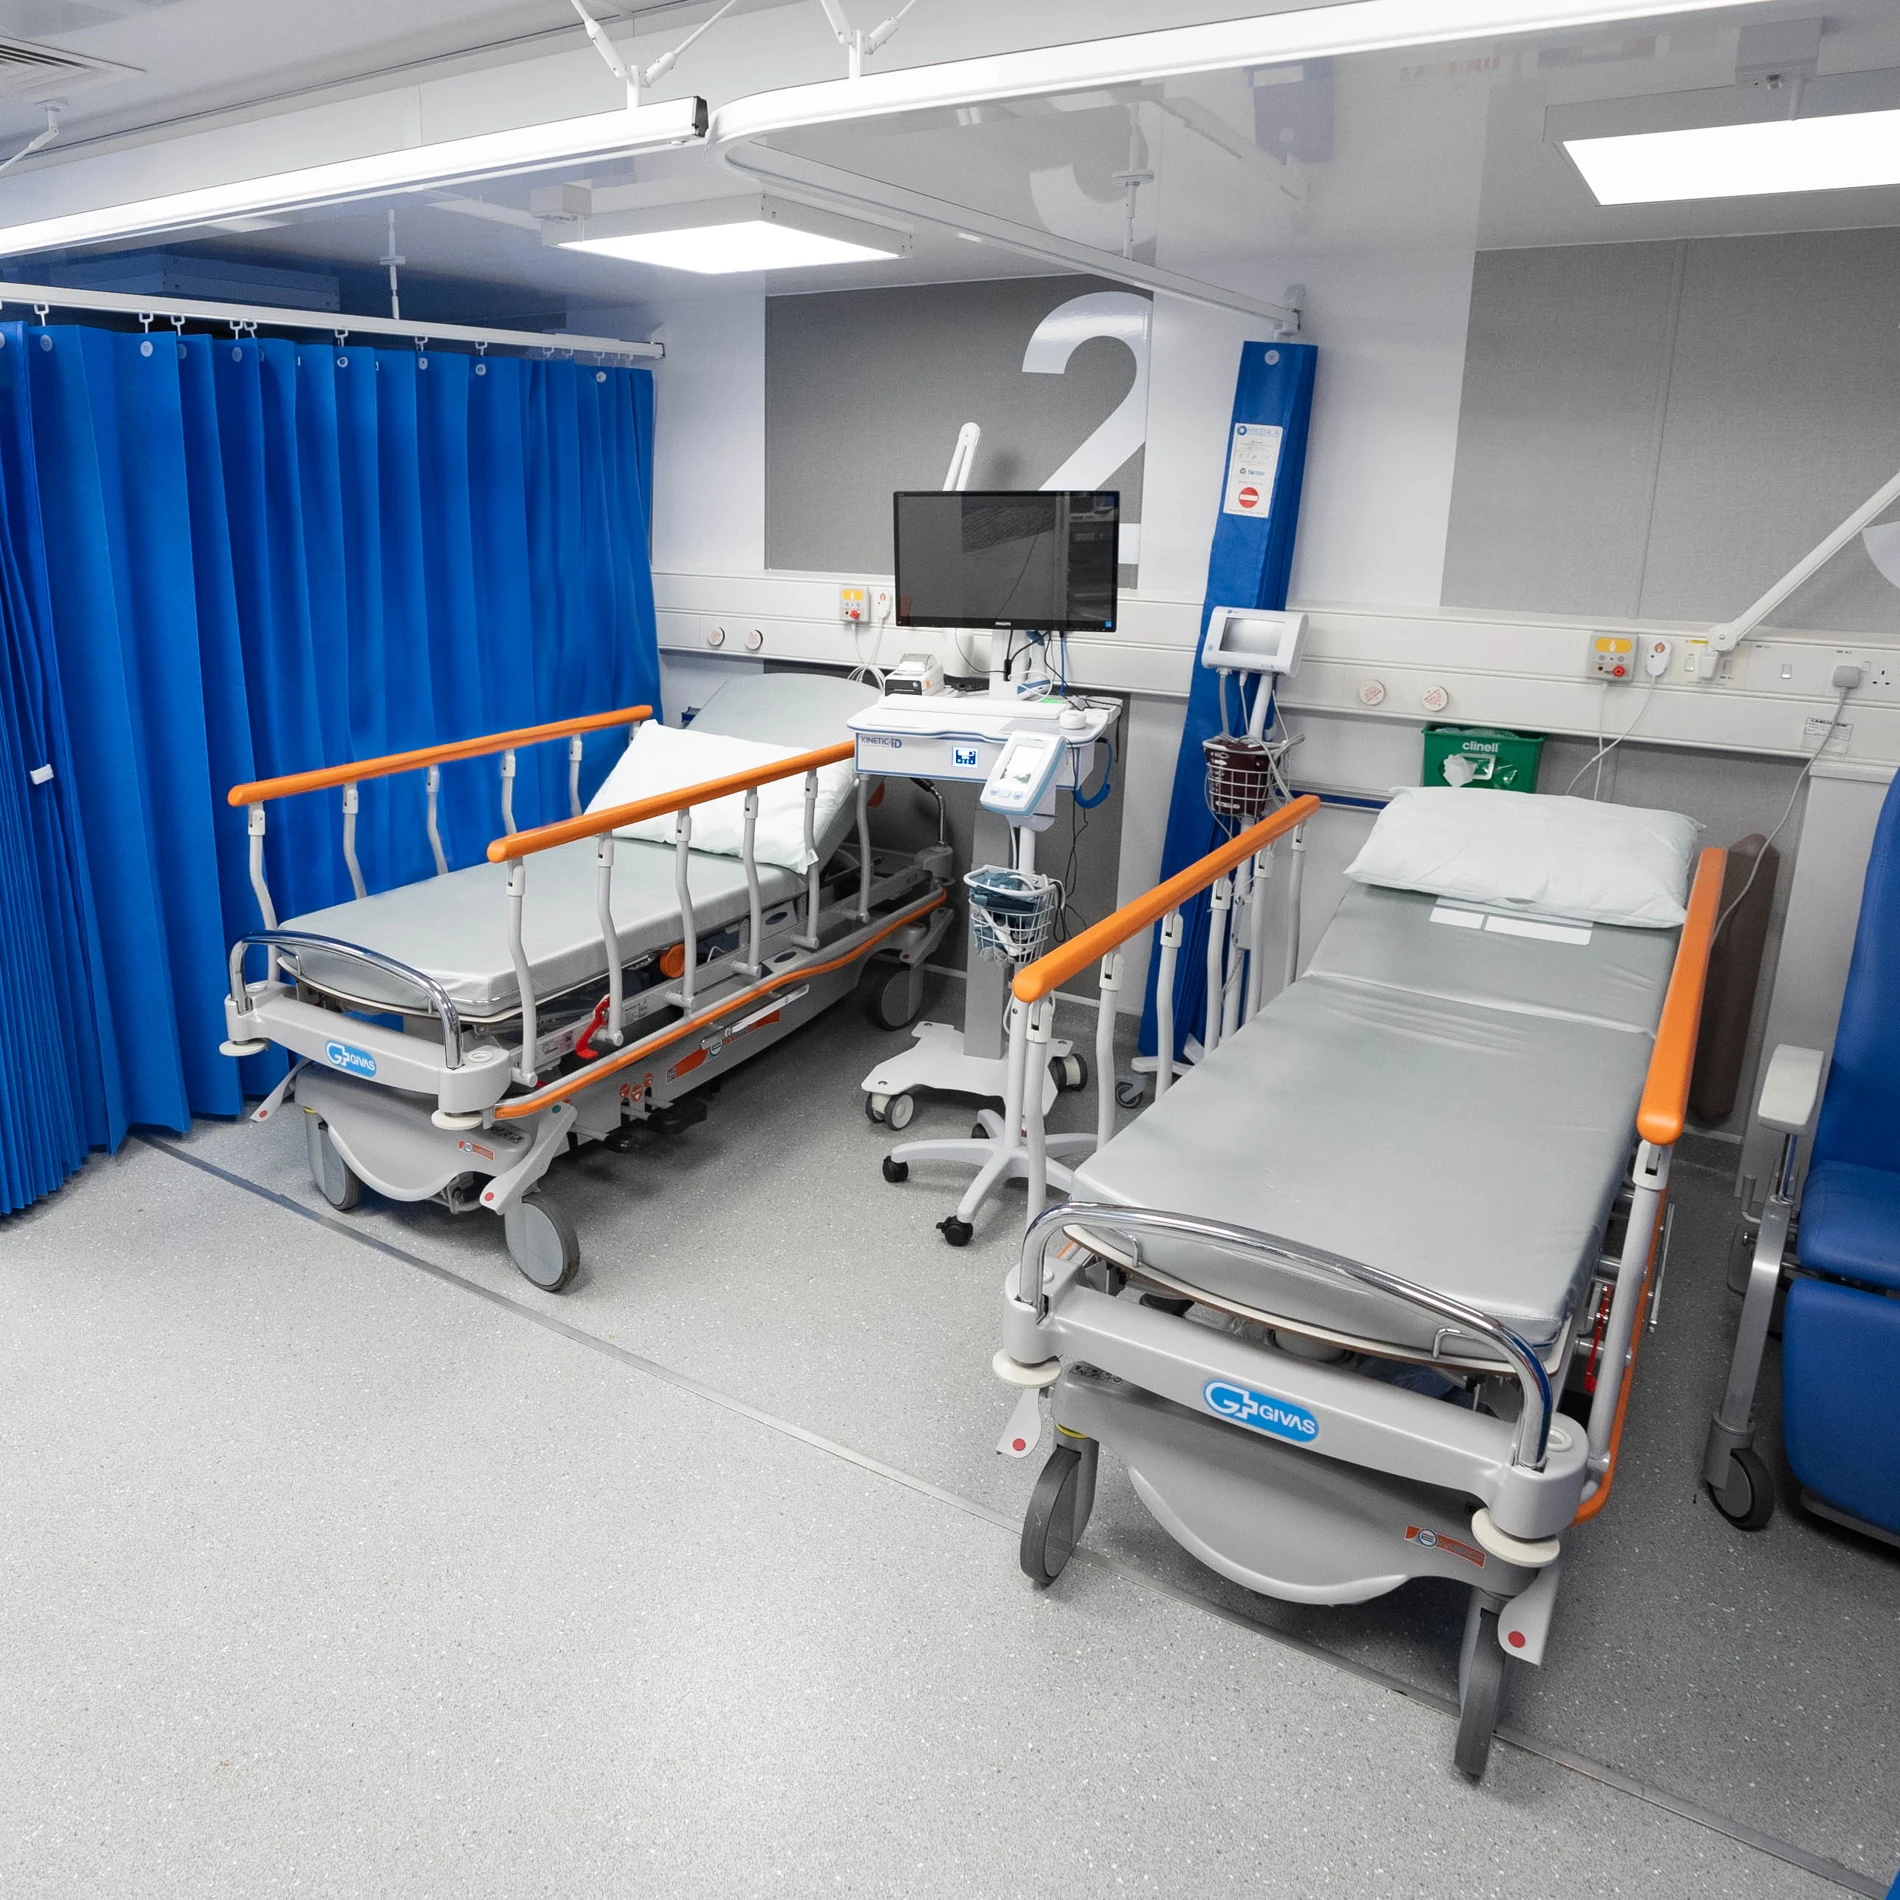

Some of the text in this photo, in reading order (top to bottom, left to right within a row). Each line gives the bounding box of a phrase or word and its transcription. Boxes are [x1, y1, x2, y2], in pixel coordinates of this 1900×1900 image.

[1022, 291, 1153, 564] 2
[1462, 741, 1499, 752] clinell
[350, 1054, 376, 1071] GIVAS
[1260, 1405, 1316, 1435] GIVAS
